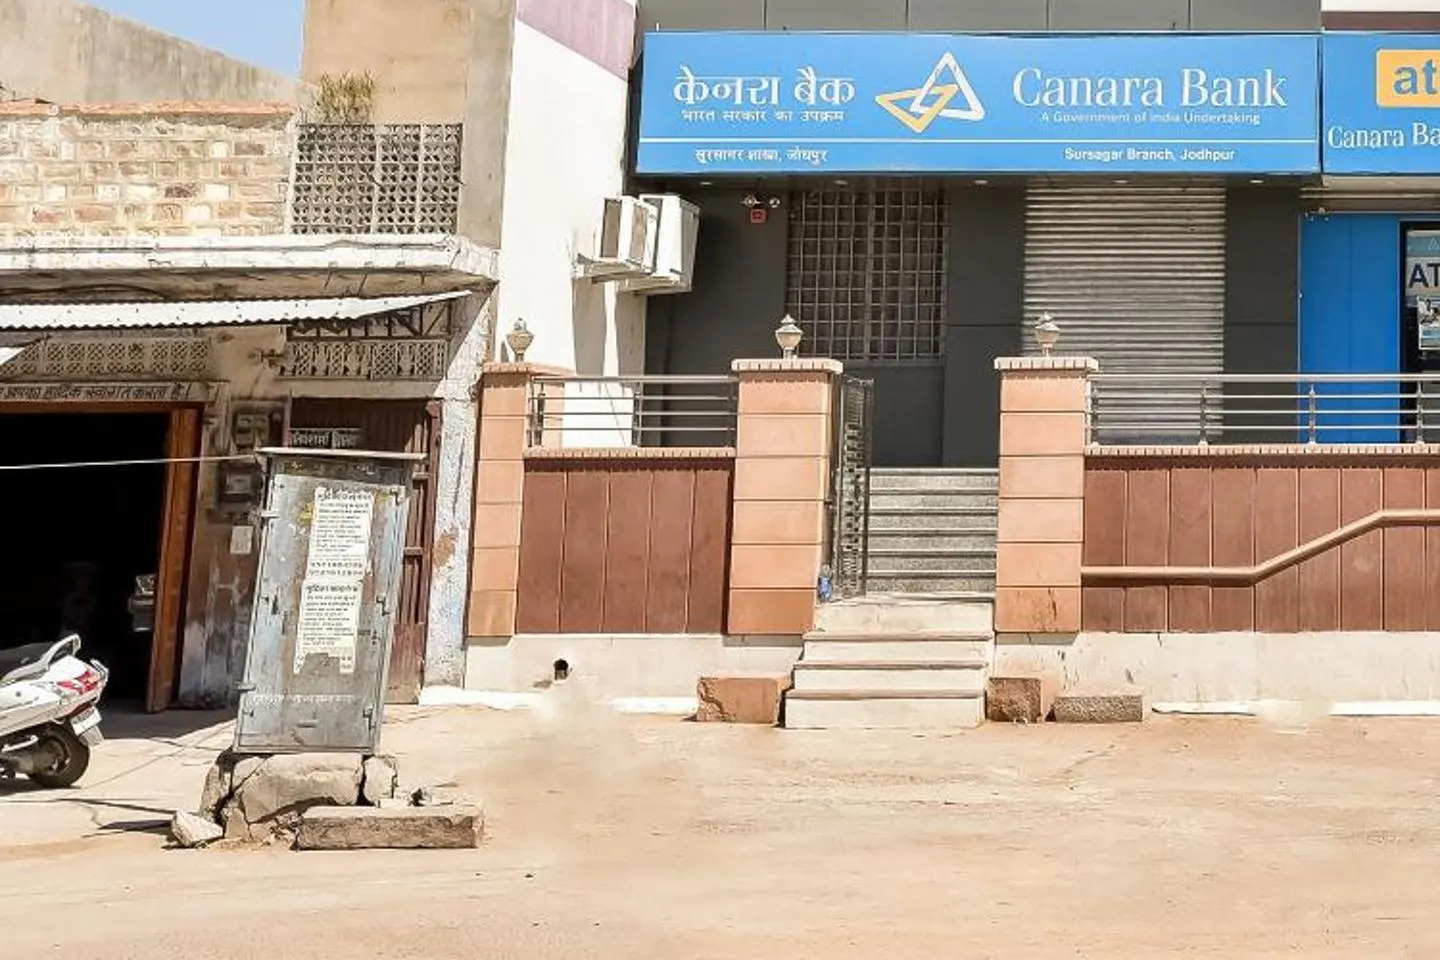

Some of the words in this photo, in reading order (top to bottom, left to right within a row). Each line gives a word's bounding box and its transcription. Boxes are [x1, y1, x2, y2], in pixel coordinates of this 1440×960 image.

[1012, 67, 1164, 107] Canara
[1181, 68, 1288, 107] Bank
[1041, 112, 1049, 122] A
[1053, 111, 1130, 124] Government
[1134, 111, 1147, 123] of
[1183, 112, 1261, 126] Undertaking
[1327, 125, 1404, 149] Canara
[1064, 148, 1123, 162] Sursagar
[1180, 149, 1236, 162] Jodhpur
